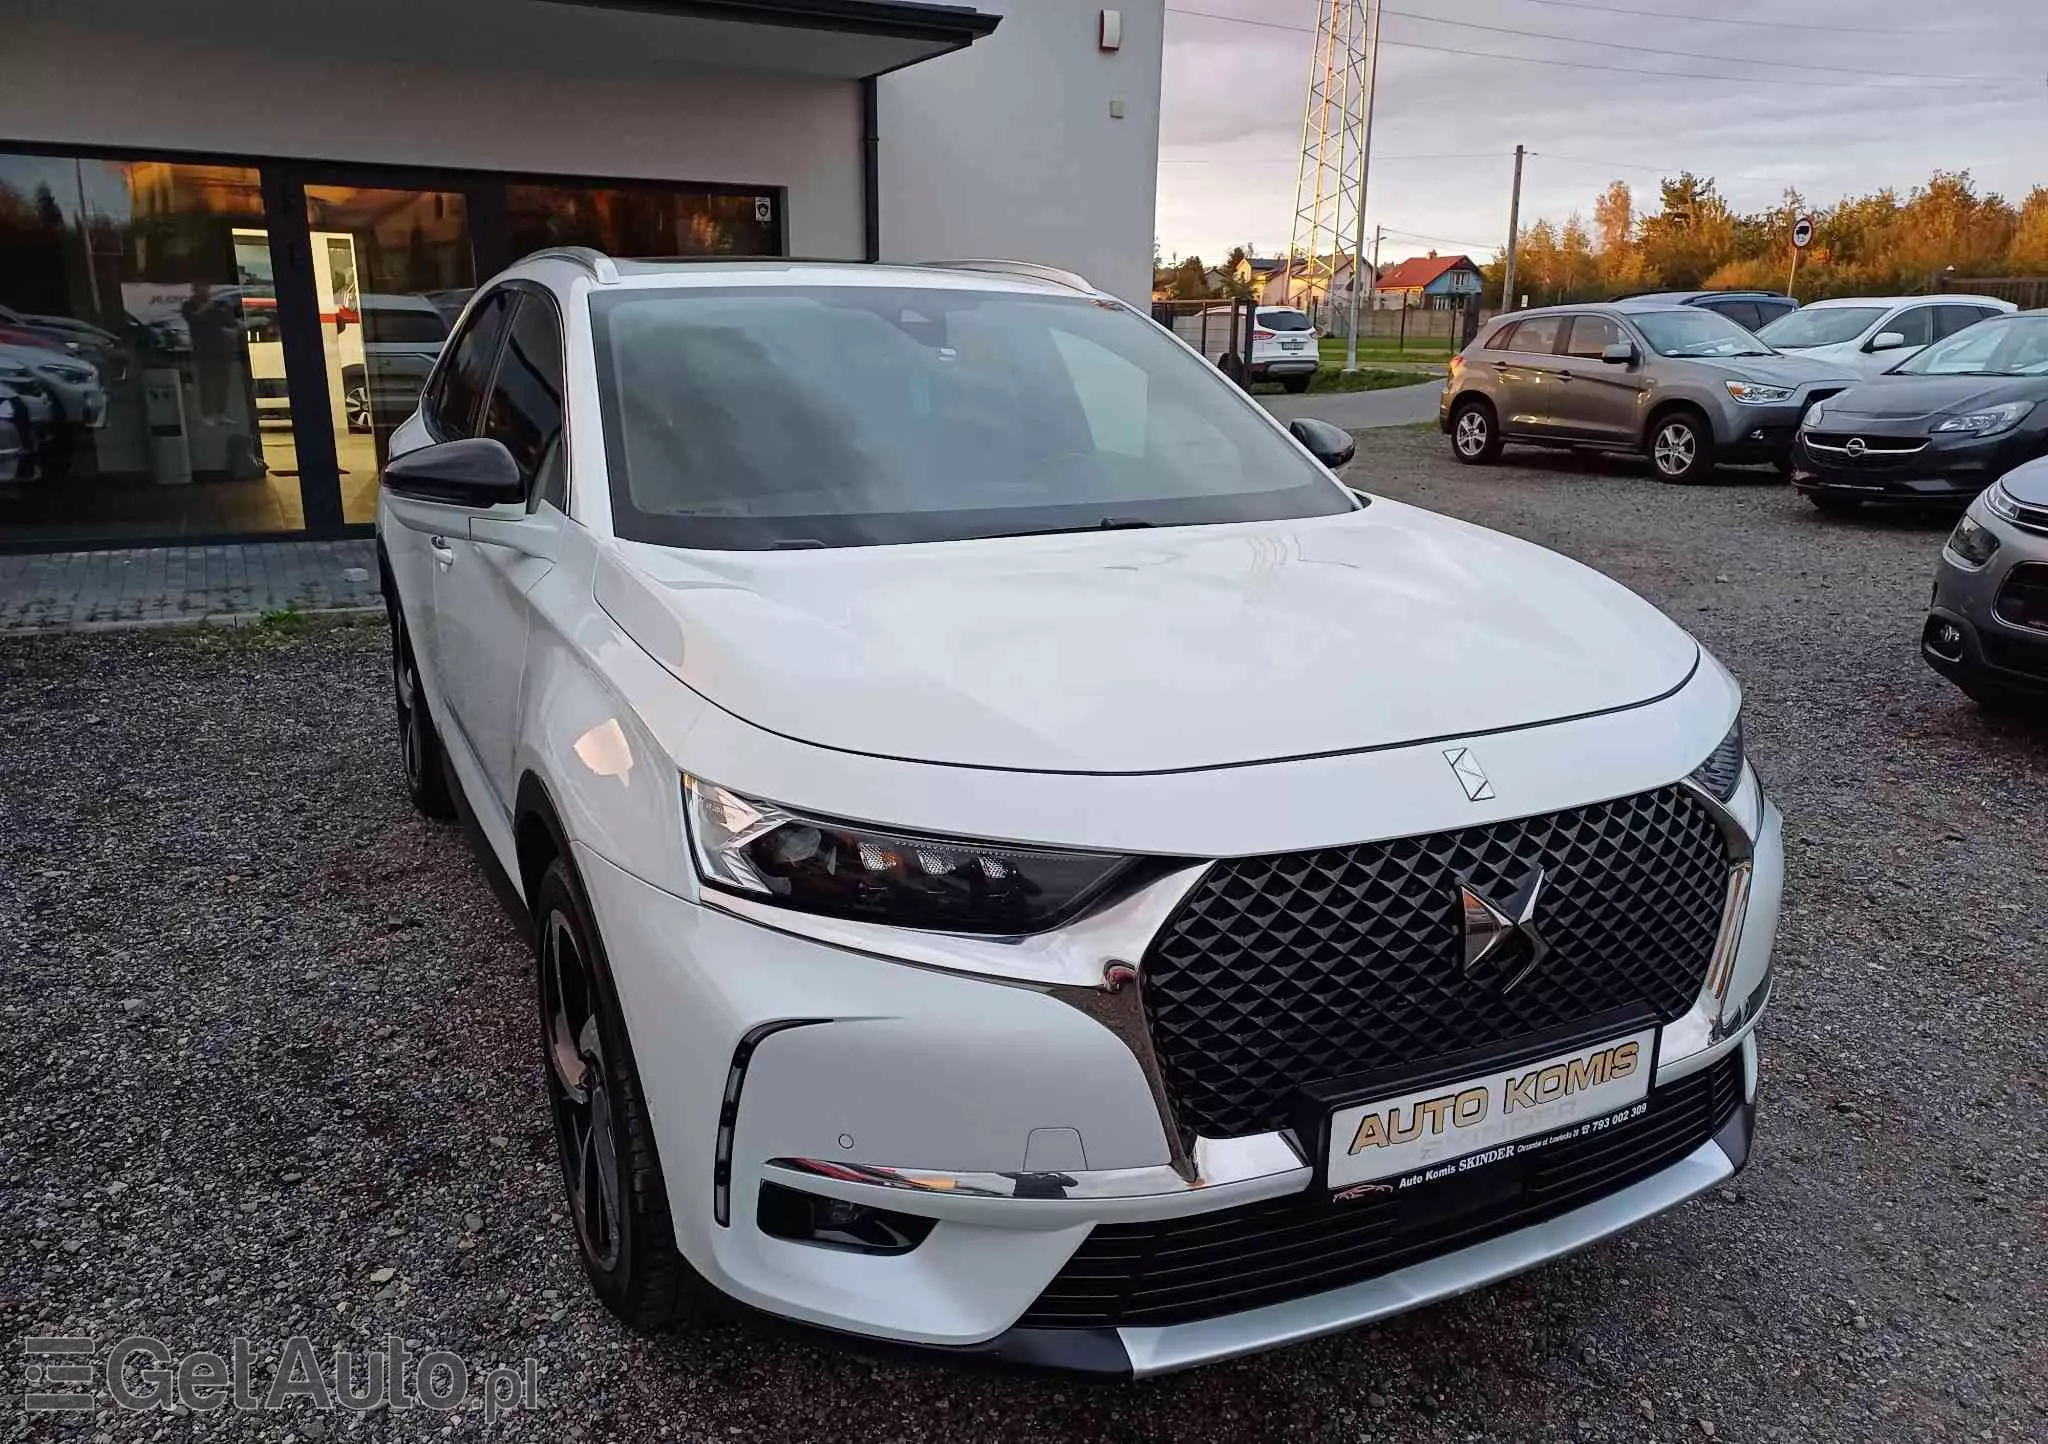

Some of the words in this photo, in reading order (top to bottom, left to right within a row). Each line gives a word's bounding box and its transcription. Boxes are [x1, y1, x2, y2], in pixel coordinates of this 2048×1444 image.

[1347, 1086, 1489, 1155] AUTO
[1503, 1040, 1640, 1114] KOMIS
[1398, 1174, 1423, 1190] Auto
[1425, 1164, 1457, 1181] Komis
[1458, 1145, 1515, 1172] SKINDER
[1592, 1117, 1610, 1132] 793
[1611, 1110, 1630, 1125] 002
[1631, 1102, 1647, 1118] 309
